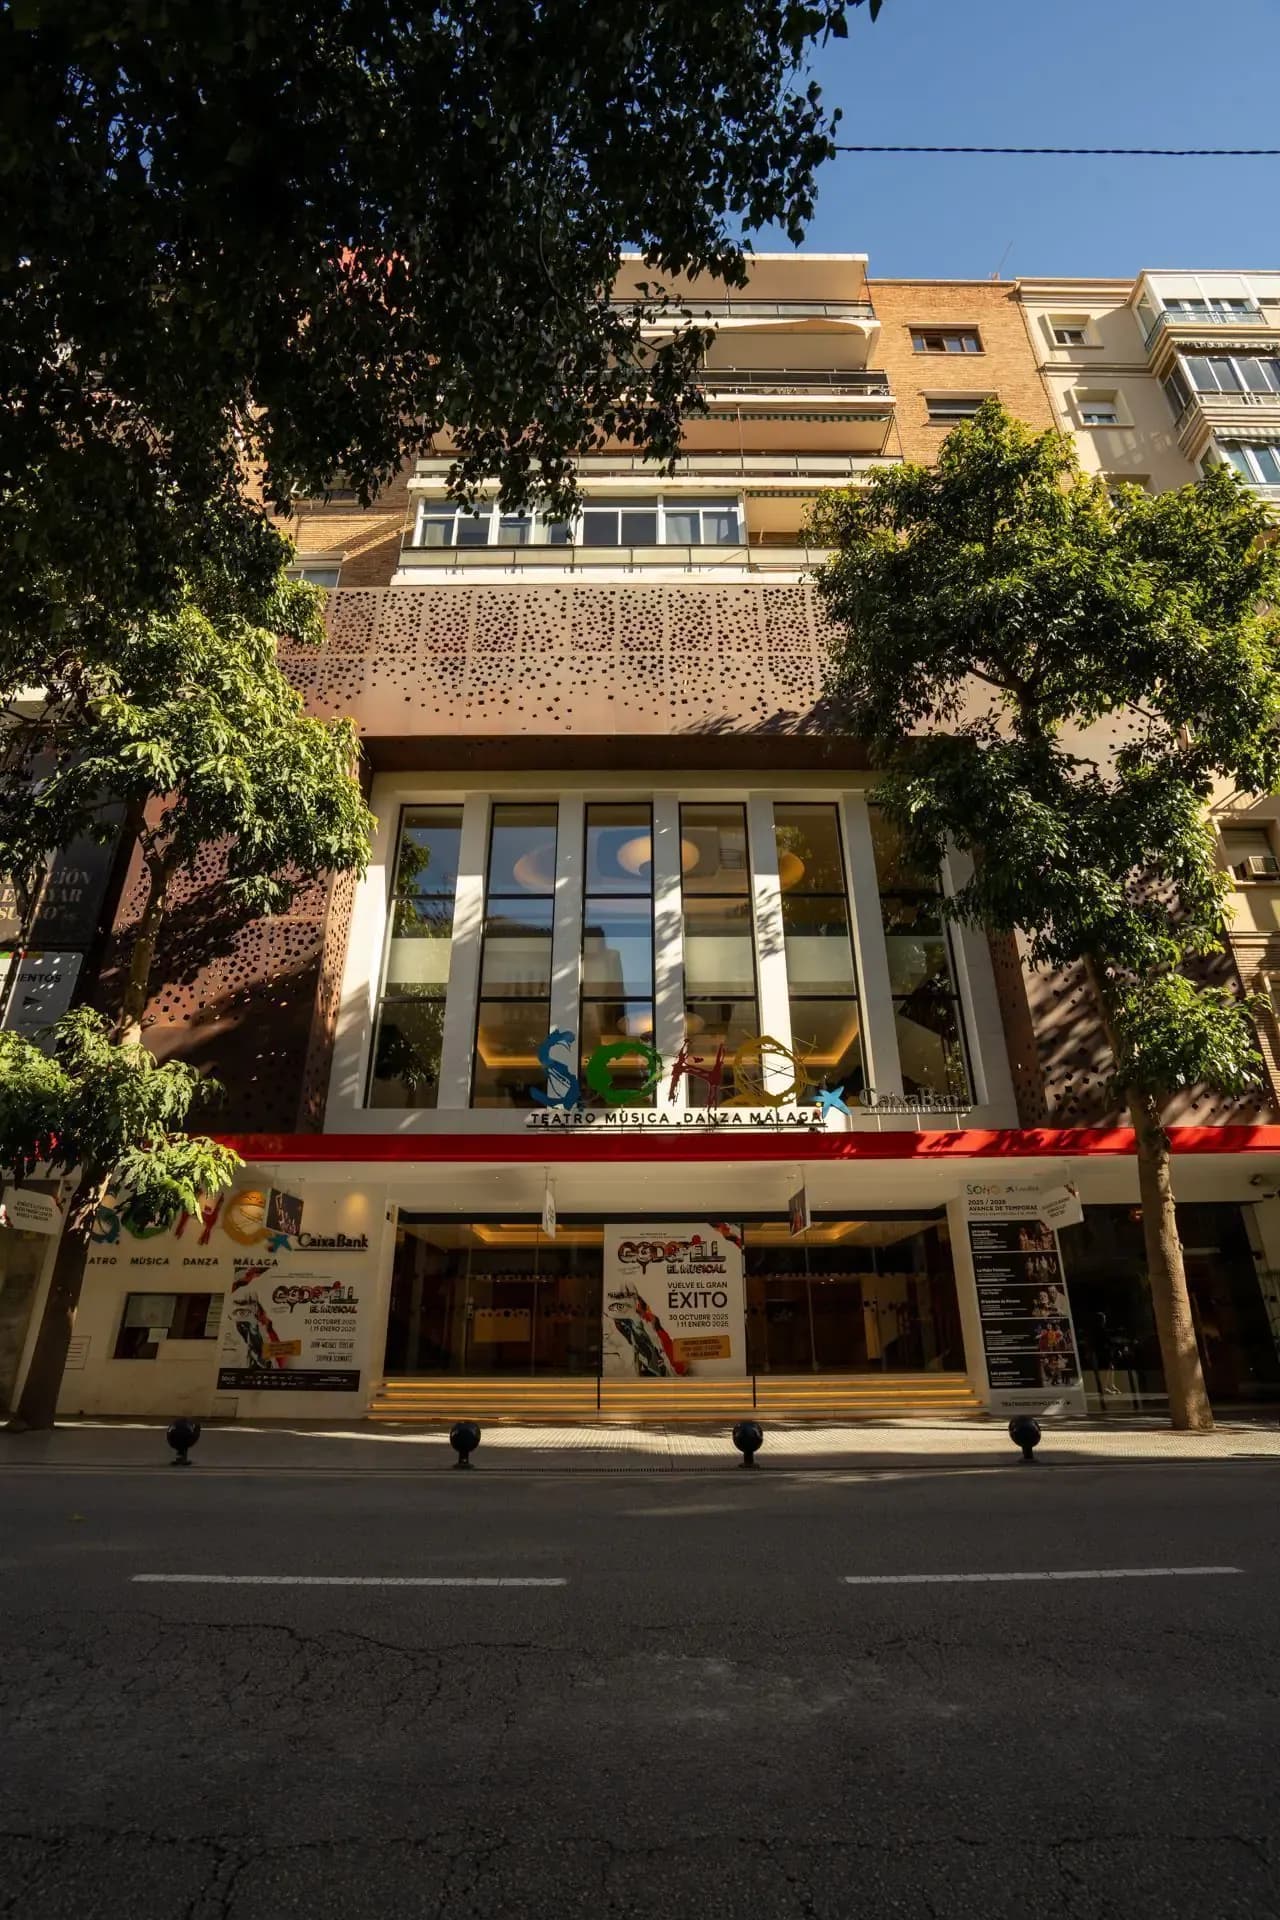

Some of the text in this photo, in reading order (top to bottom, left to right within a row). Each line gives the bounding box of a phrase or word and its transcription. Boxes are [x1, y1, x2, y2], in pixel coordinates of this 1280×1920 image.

[530, 1028, 818, 1113] SOHO
[531, 1109, 821, 1125] TEATRO MÚSICA DANZA MÁLAGA
[298, 1232, 369, 1249] CaixaBank
[88, 1255, 279, 1267] ATRO MÚSICA DANZA MÁLAGA
[680, 1264, 727, 1274] MUSICAL
[667, 1281, 728, 1289] VUELVE EL GRAN
[667, 1290, 728, 1309] ÉXITO
